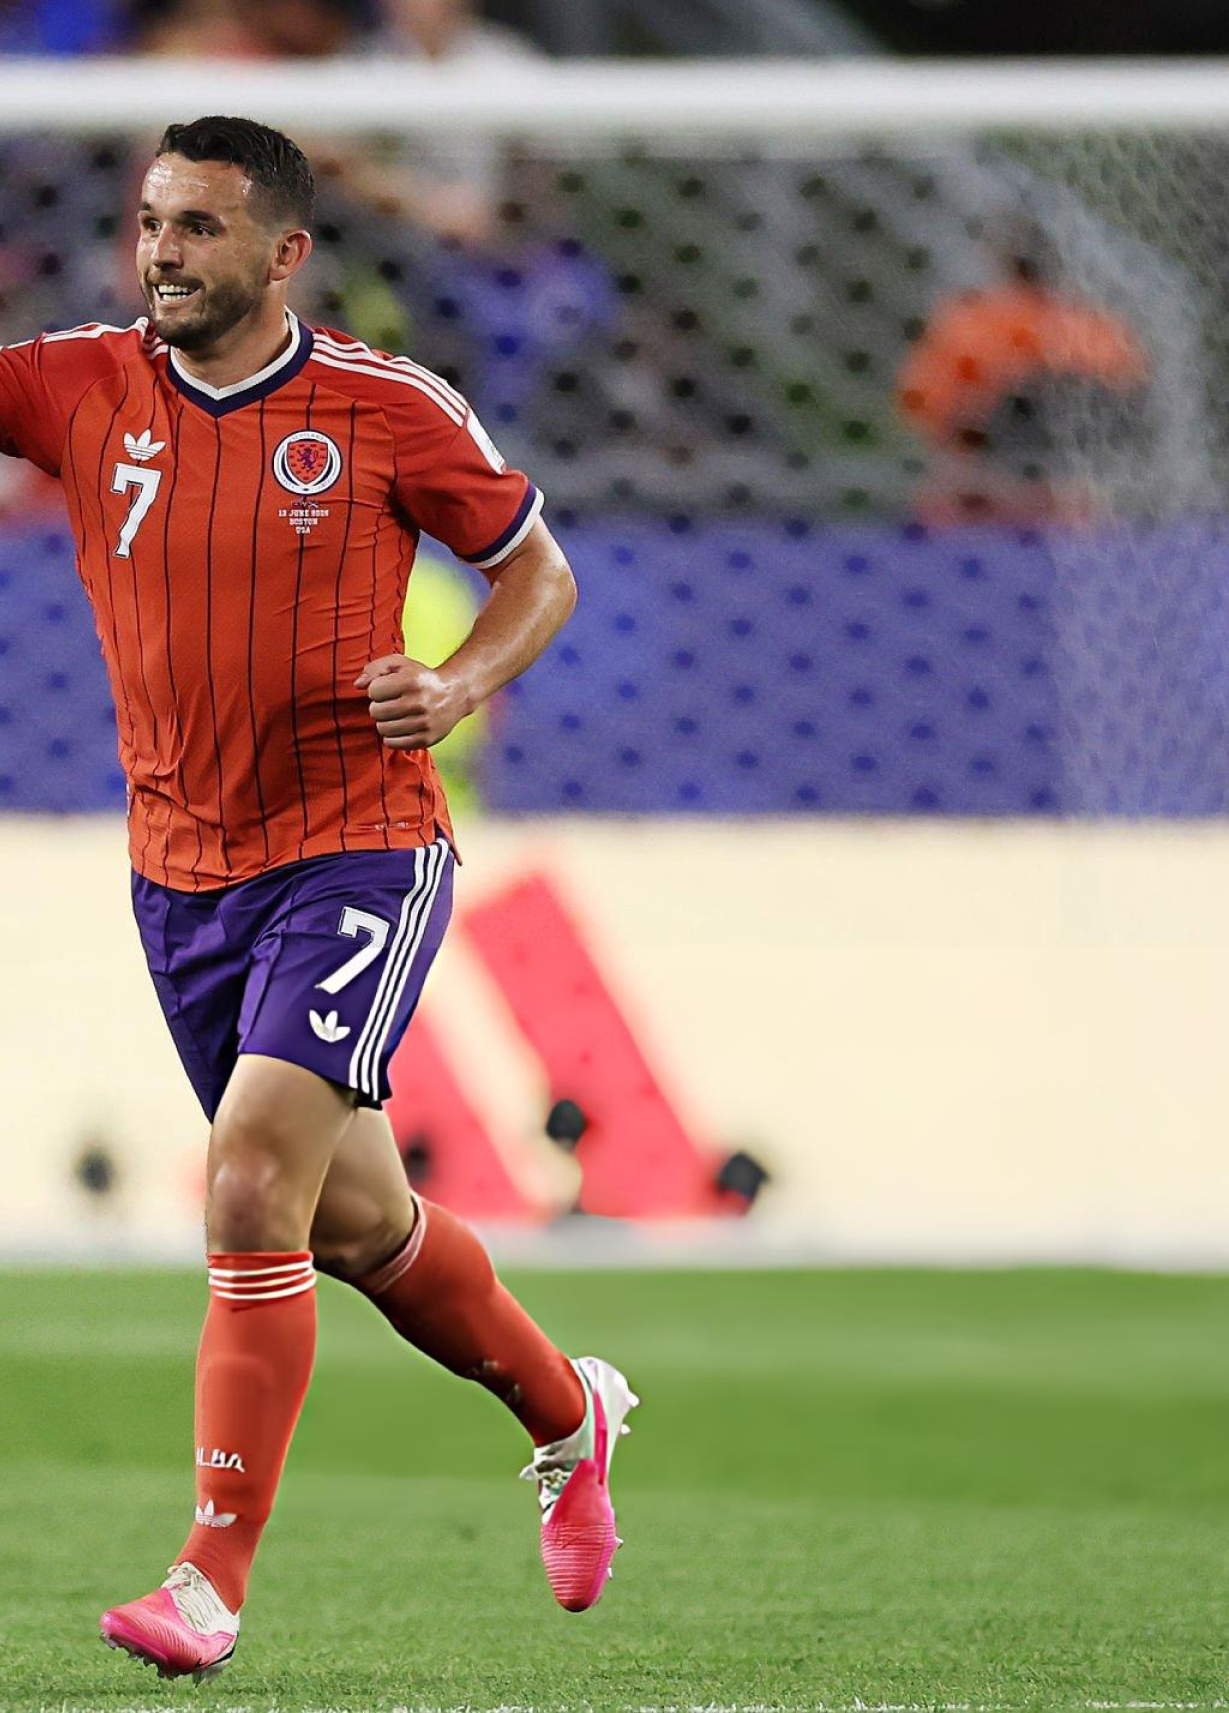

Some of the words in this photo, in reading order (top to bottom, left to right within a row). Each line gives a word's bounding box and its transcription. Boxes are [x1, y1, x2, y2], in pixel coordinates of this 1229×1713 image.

[110, 462, 162, 560] 7
[288, 509, 310, 518] JUNE
[289, 517, 318, 526] BOSTON
[295, 526, 311, 535] USA
[314, 906, 391, 995] 7
[195, 1445, 246, 1473] LBA
